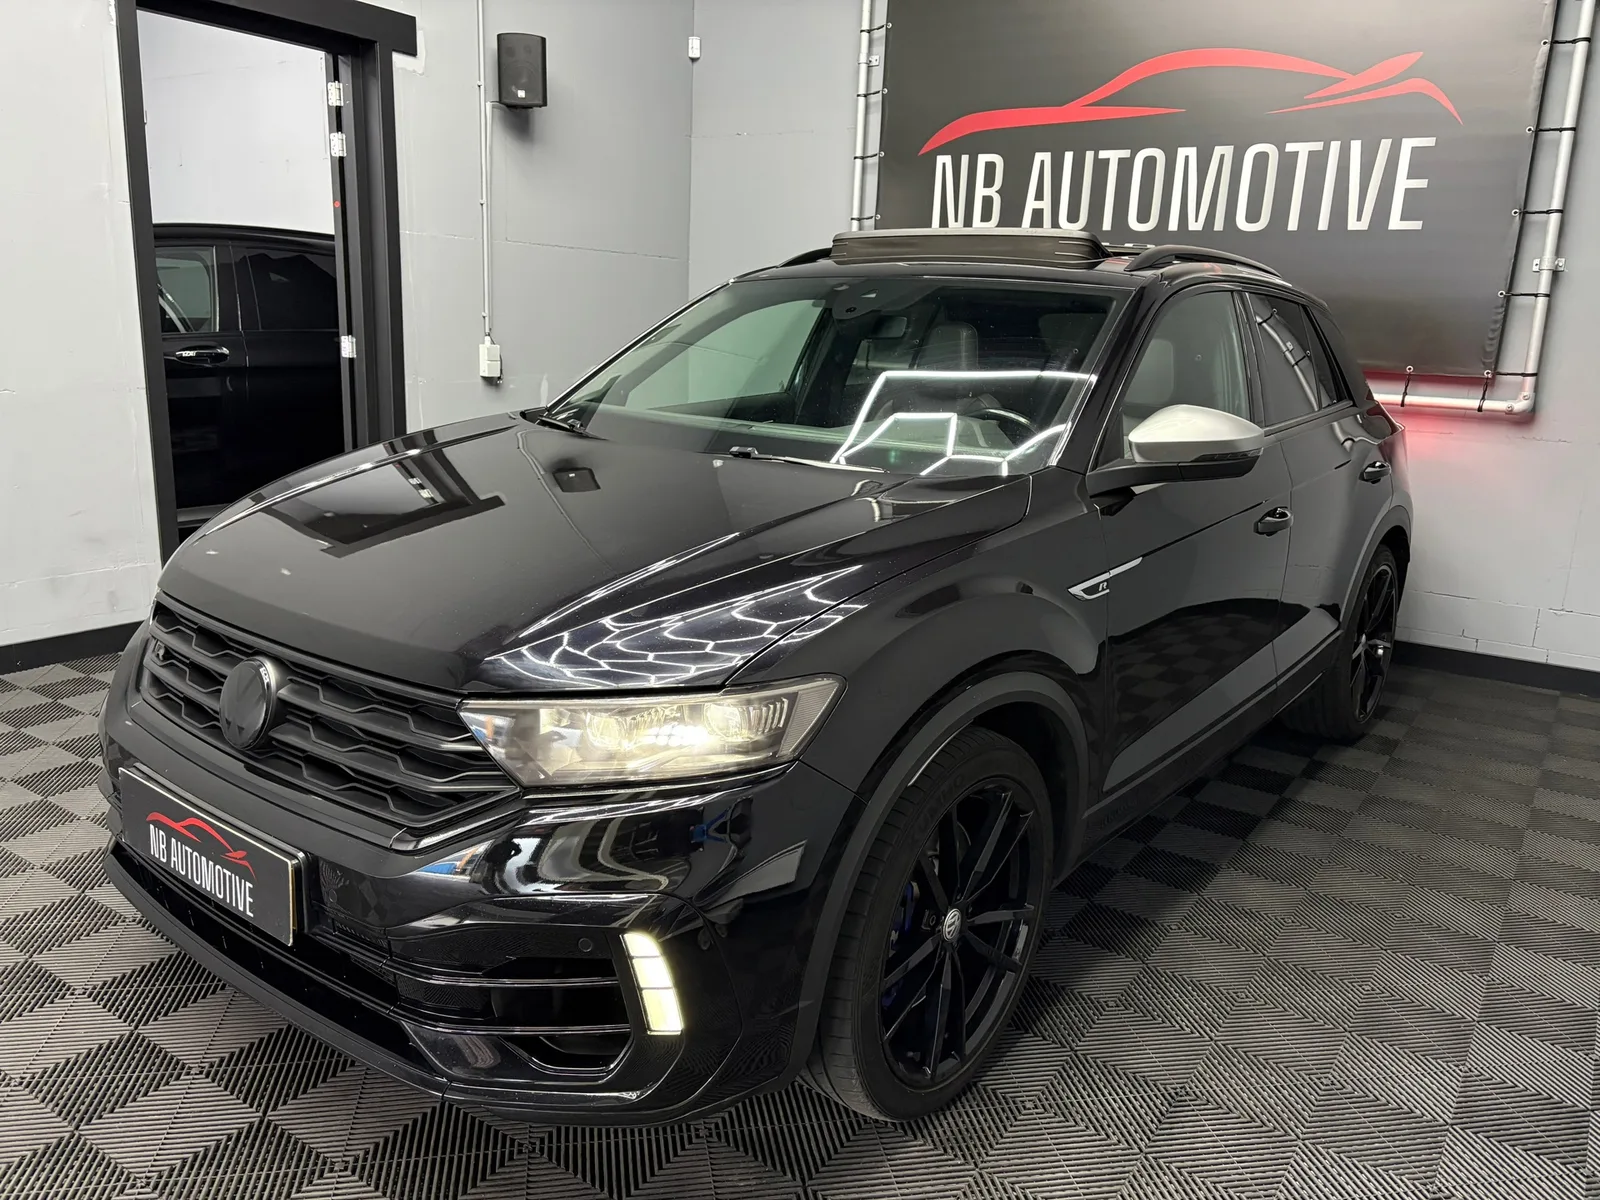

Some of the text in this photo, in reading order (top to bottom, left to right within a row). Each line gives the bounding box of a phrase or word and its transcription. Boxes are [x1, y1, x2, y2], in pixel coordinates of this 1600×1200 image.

[931, 136, 1437, 232] NB AUTOMOTIVE
[149, 823, 254, 917] NB AUTOMOTIVE
